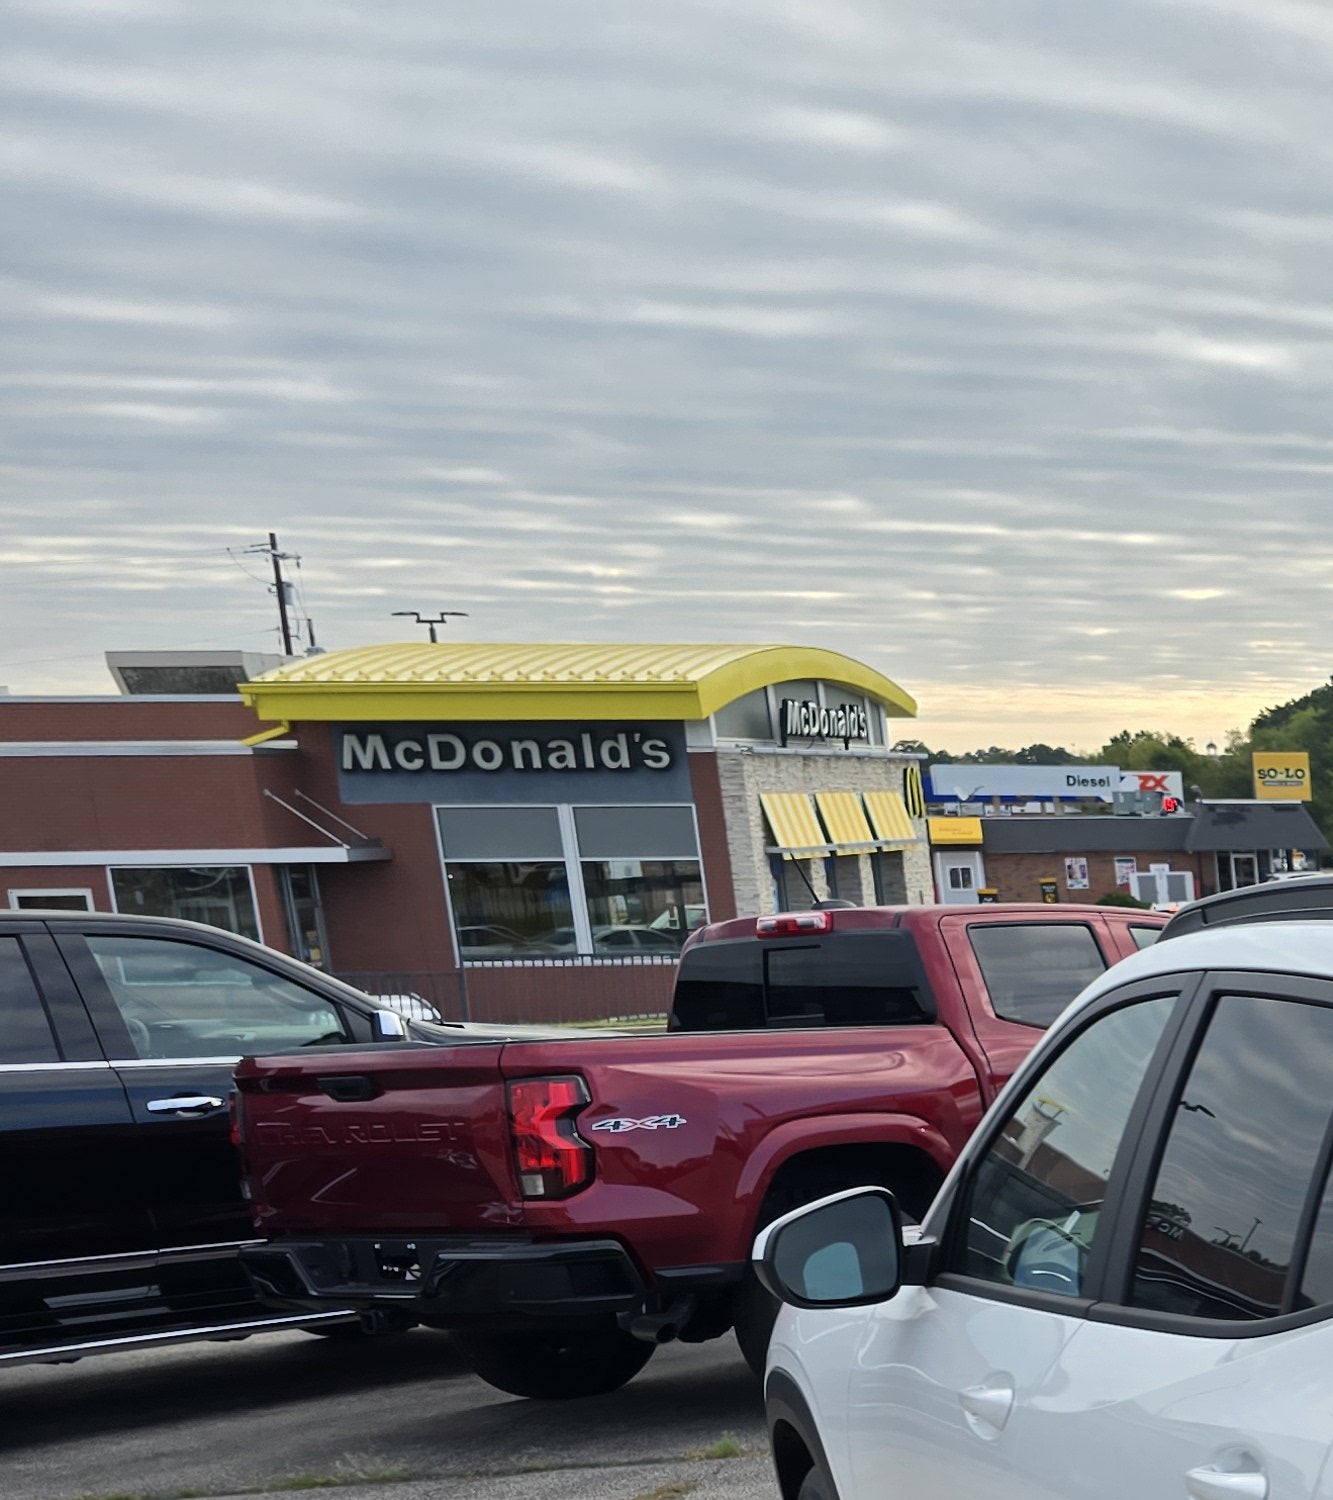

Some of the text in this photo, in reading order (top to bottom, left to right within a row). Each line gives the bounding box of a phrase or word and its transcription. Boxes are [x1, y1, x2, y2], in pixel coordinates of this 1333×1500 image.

[787, 700, 867, 737] McDonald's
[342, 732, 671, 771] McDonald's
[1066, 775, 1111, 788] Diesel
[1257, 768, 1305, 779] SO-LO
